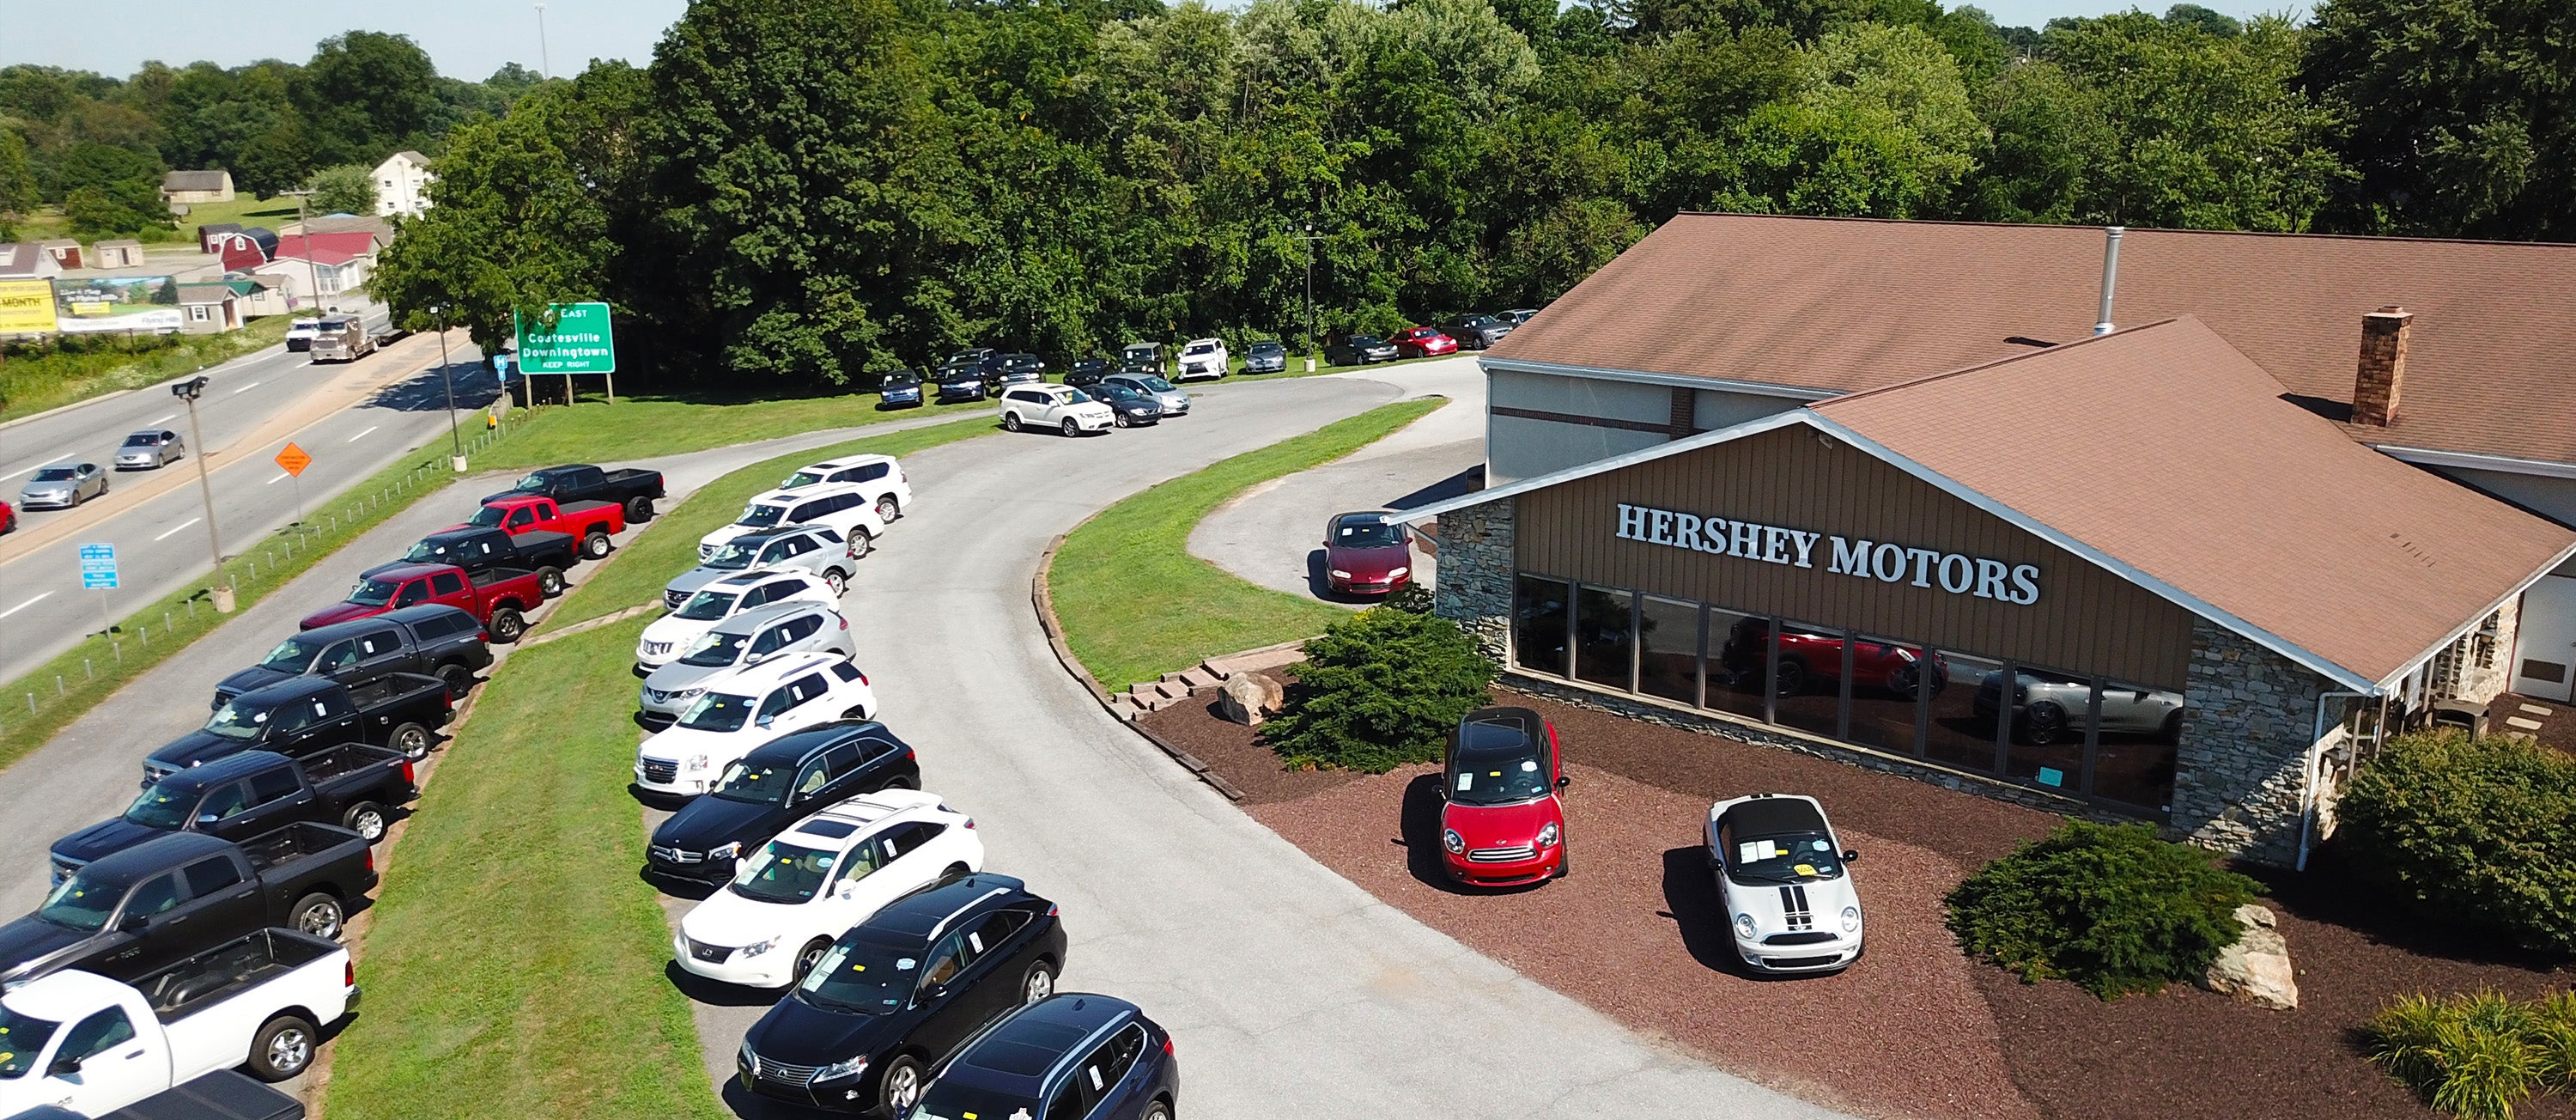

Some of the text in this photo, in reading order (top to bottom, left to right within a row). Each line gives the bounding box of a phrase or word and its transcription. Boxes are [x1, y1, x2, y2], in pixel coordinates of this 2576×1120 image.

[560, 308, 587, 318] EAST
[528, 332, 600, 343] Coatesville
[523, 348, 609, 359] Downingtown
[1616, 503, 2039, 606] HERSHEY MOTORS
